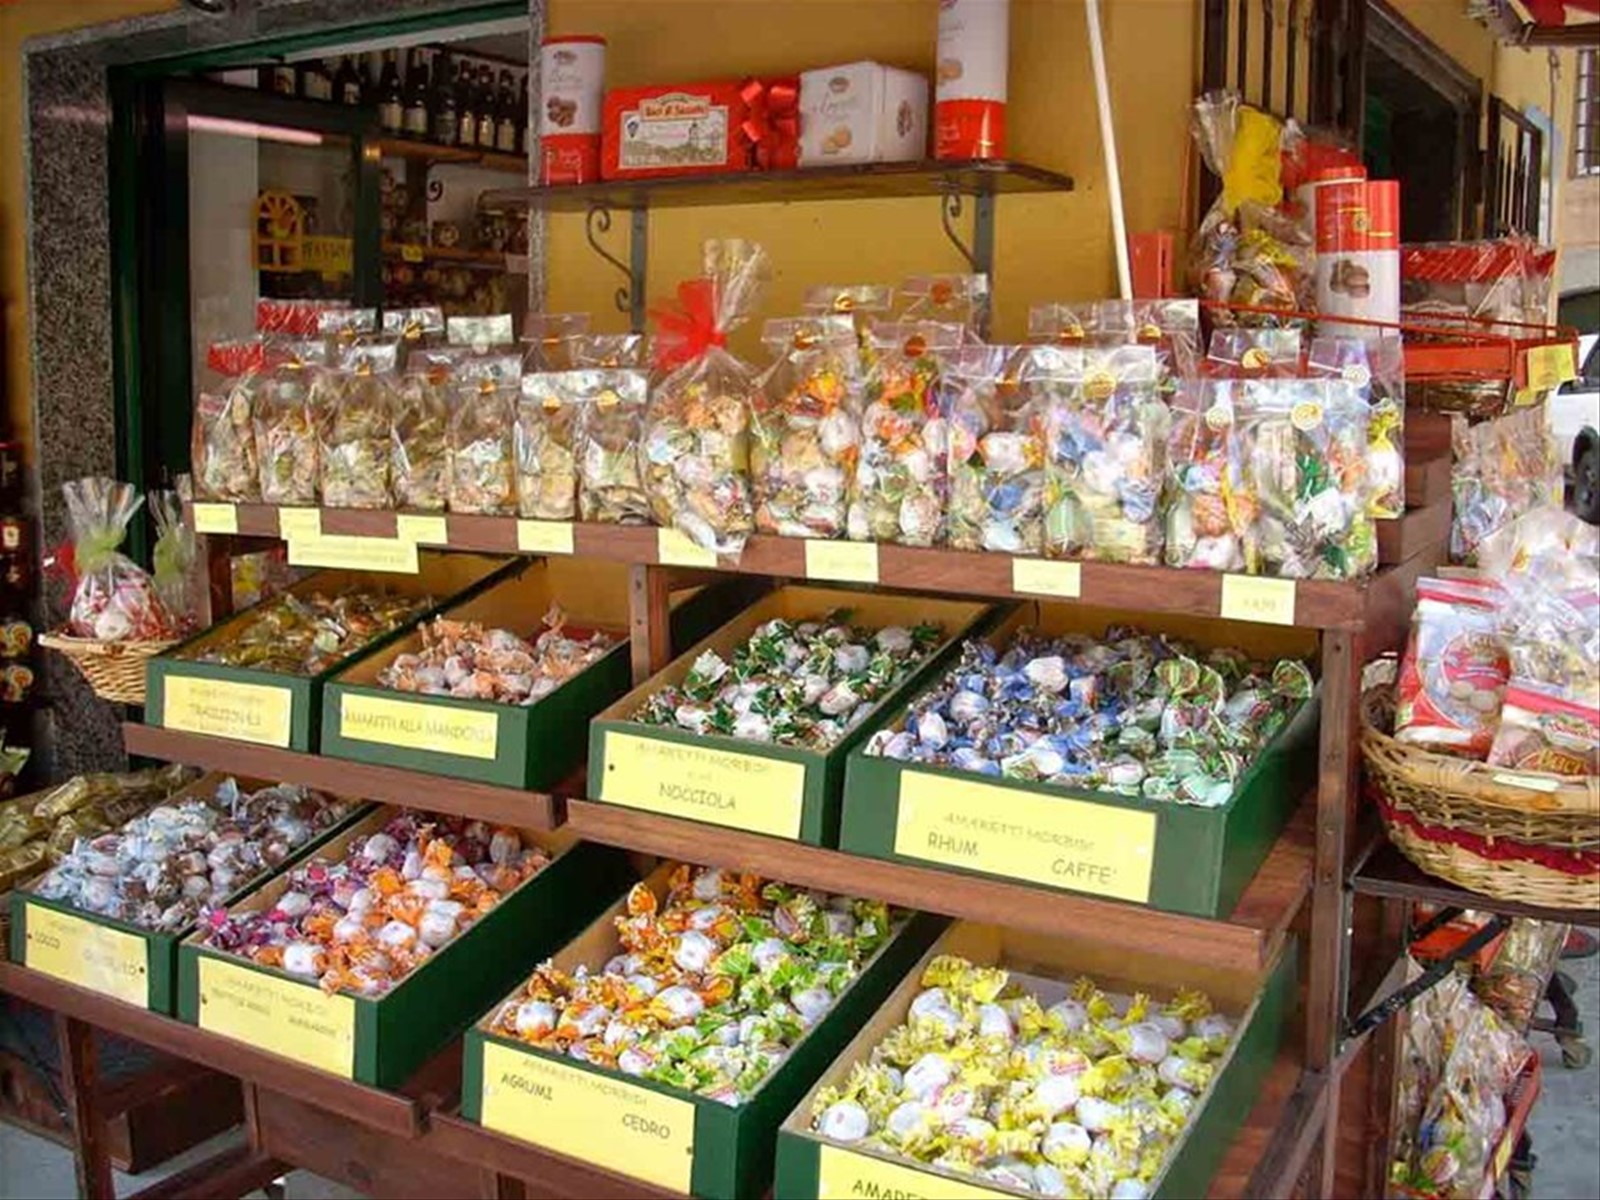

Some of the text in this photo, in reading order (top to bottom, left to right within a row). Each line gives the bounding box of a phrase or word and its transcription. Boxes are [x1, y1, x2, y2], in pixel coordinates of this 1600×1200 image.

[658, 781, 737, 811] NOCCIOLA
[943, 812, 1024, 838] AMARETTI
[927, 831, 979, 857] RHUM
[500, 1072, 553, 1101] AGRUMI
[621, 1112, 671, 1140] CEDRO
